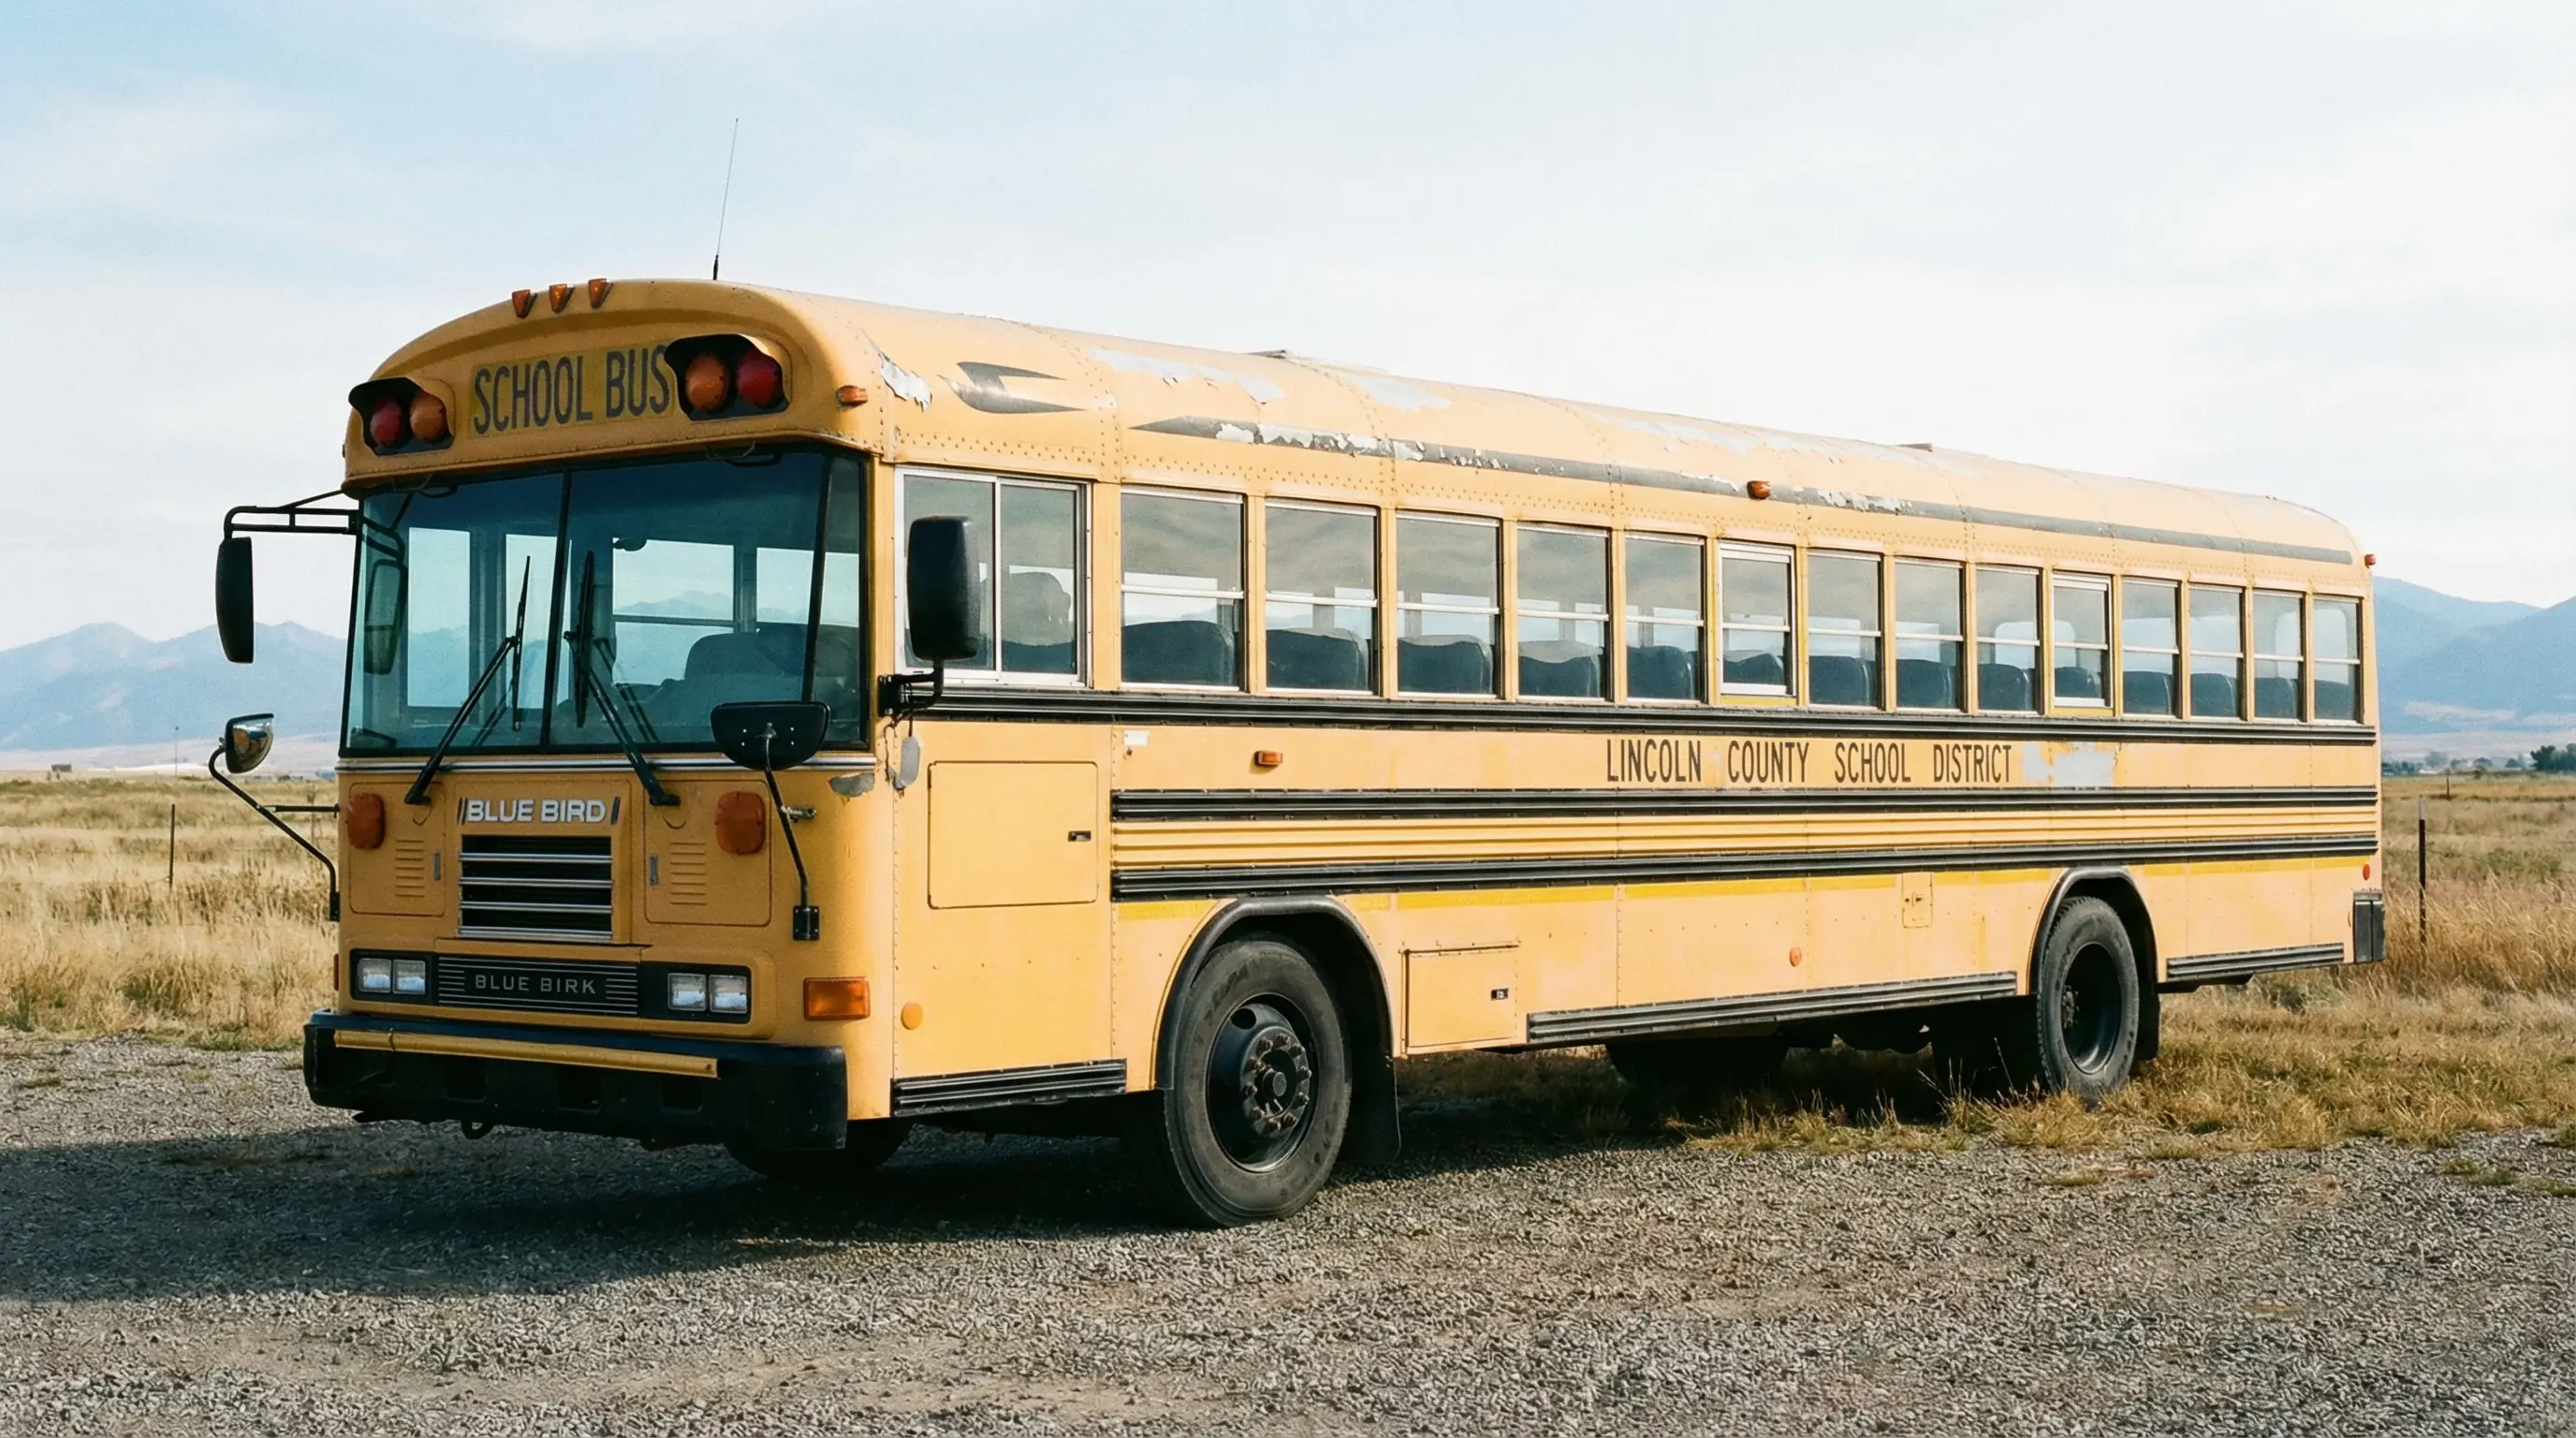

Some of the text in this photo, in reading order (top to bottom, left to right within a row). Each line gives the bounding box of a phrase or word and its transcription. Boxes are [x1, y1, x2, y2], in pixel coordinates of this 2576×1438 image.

[474, 345, 669, 434] SCHOOL BUS
[1607, 739, 2012, 783] LINCOLN COUNTY SCHOOL DISTRICT
[467, 799, 607, 823] BLUE BIRD
[475, 974, 596, 994] BLUE BIRK
